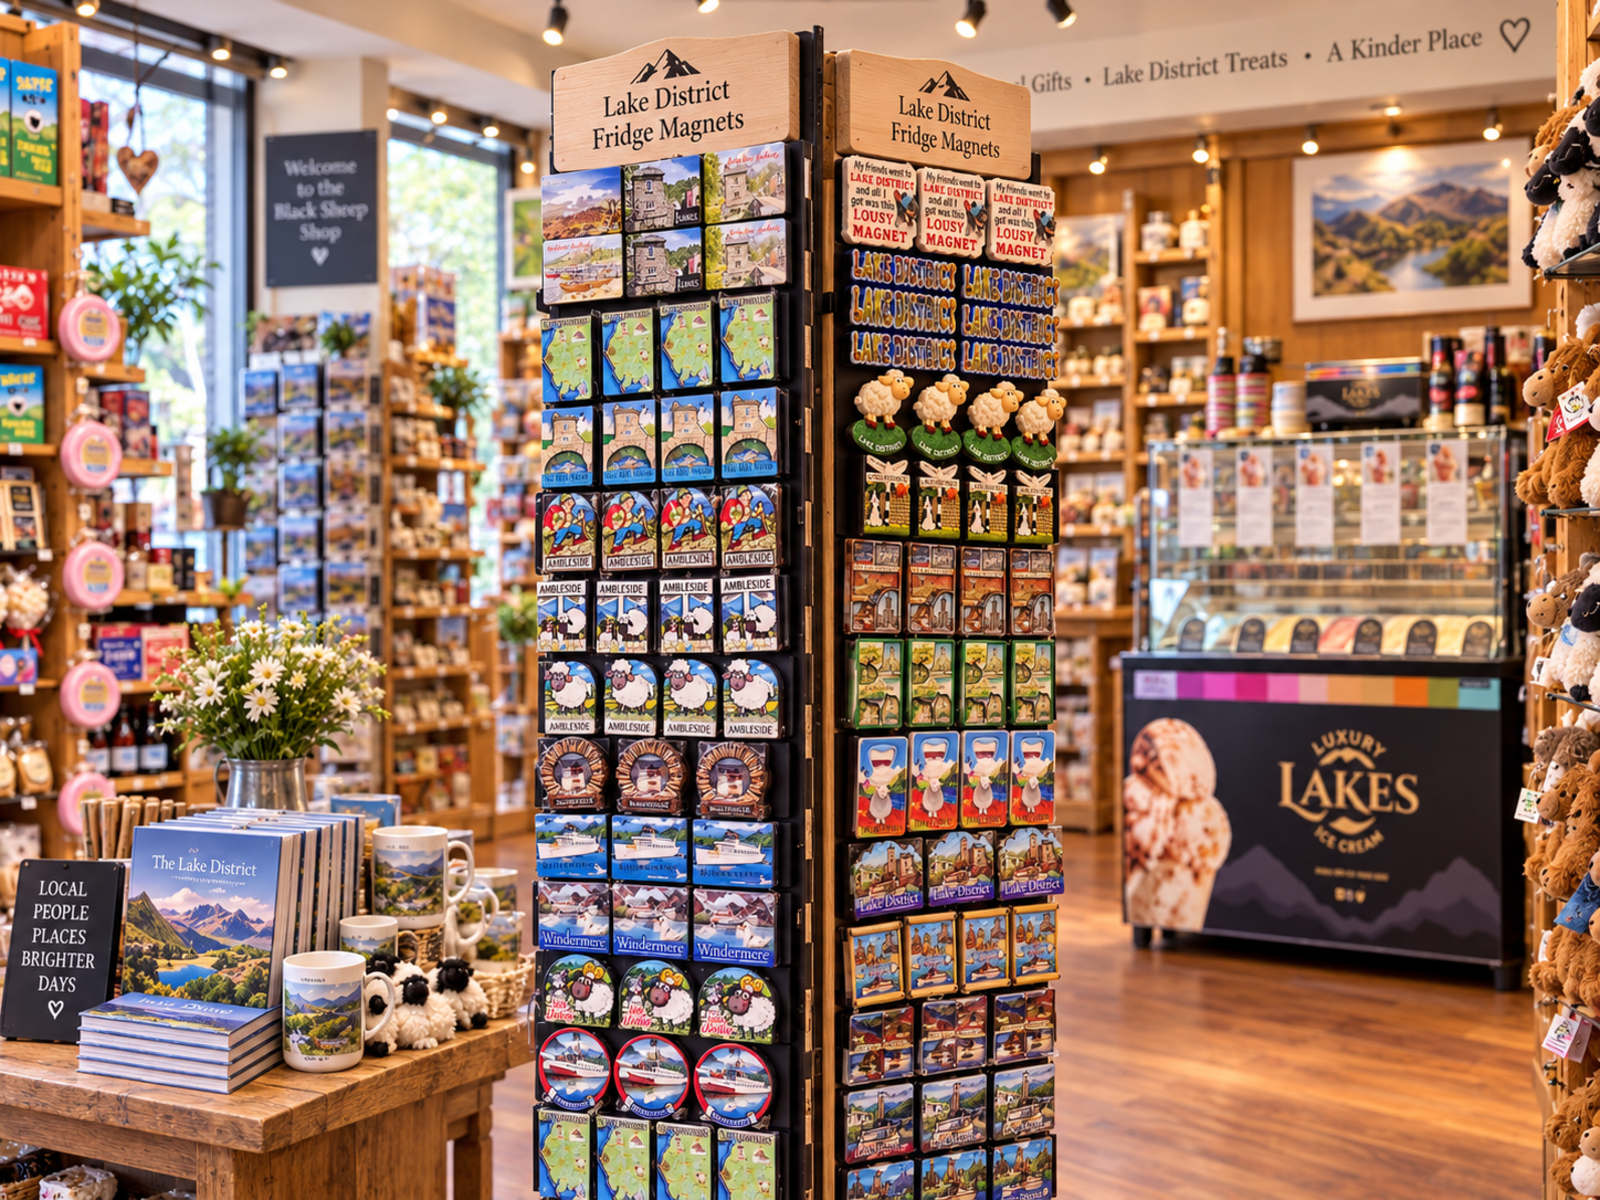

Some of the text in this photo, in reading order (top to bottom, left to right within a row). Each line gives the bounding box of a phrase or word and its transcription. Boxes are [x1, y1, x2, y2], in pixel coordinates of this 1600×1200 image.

[1032, 72, 1071, 93] Gifts
[1103, 65, 1143, 85] Lake
[1149, 57, 1219, 81] District
[1225, 50, 1288, 73] Treats
[1327, 42, 1343, 62] A
[1351, 34, 1421, 60] Kinder
[1428, 29, 1482, 52] Place
[604, 80, 730, 117] Lake District
[899, 96, 991, 130] Lake District
[592, 112, 744, 150] Fridge Magnets
[891, 122, 1000, 159] Fridge Magnets
[284, 158, 357, 177] Welcome
[297, 178, 345, 198] to the
[274, 200, 368, 221] Black Sheep
[854, 208, 893, 225] LOUSY
[299, 223, 342, 244] Shop
[853, 224, 907, 243] MAGNET
[927, 218, 964, 233] LOUSY
[997, 227, 1033, 242] LOUSY
[926, 233, 977, 251] MAGNET
[996, 242, 1046, 259] MAGNET
[851, 249, 893, 284] LAKE
[962, 264, 1001, 303] LAKE
[851, 285, 893, 328] LAKE
[961, 304, 1001, 340] LAKE
[851, 331, 892, 367] LAKE
[961, 340, 1001, 375] LAKE
[539, 583, 581, 593] AMBLESIDE
[600, 583, 643, 593] AMBLESIDE
[662, 581, 708, 592] AMBLESIDE
[724, 579, 770, 591] AMBLESIDE
[1311, 729, 1387, 758] LUXURY
[1278, 761, 1420, 823] LAKES
[1314, 825, 1385, 854] ICE CREAM
[152, 855, 257, 876] The Lake District
[39, 880, 87, 897] LOCAL
[33, 904, 89, 921] PEOPLE
[32, 928, 86, 945] PLACES
[542, 930, 606, 948] Windermere
[617, 936, 684, 954] Windermere
[21, 951, 95, 969] BRIGHTER
[697, 943, 769, 960] Windermere
[38, 976, 76, 993] DAYS
